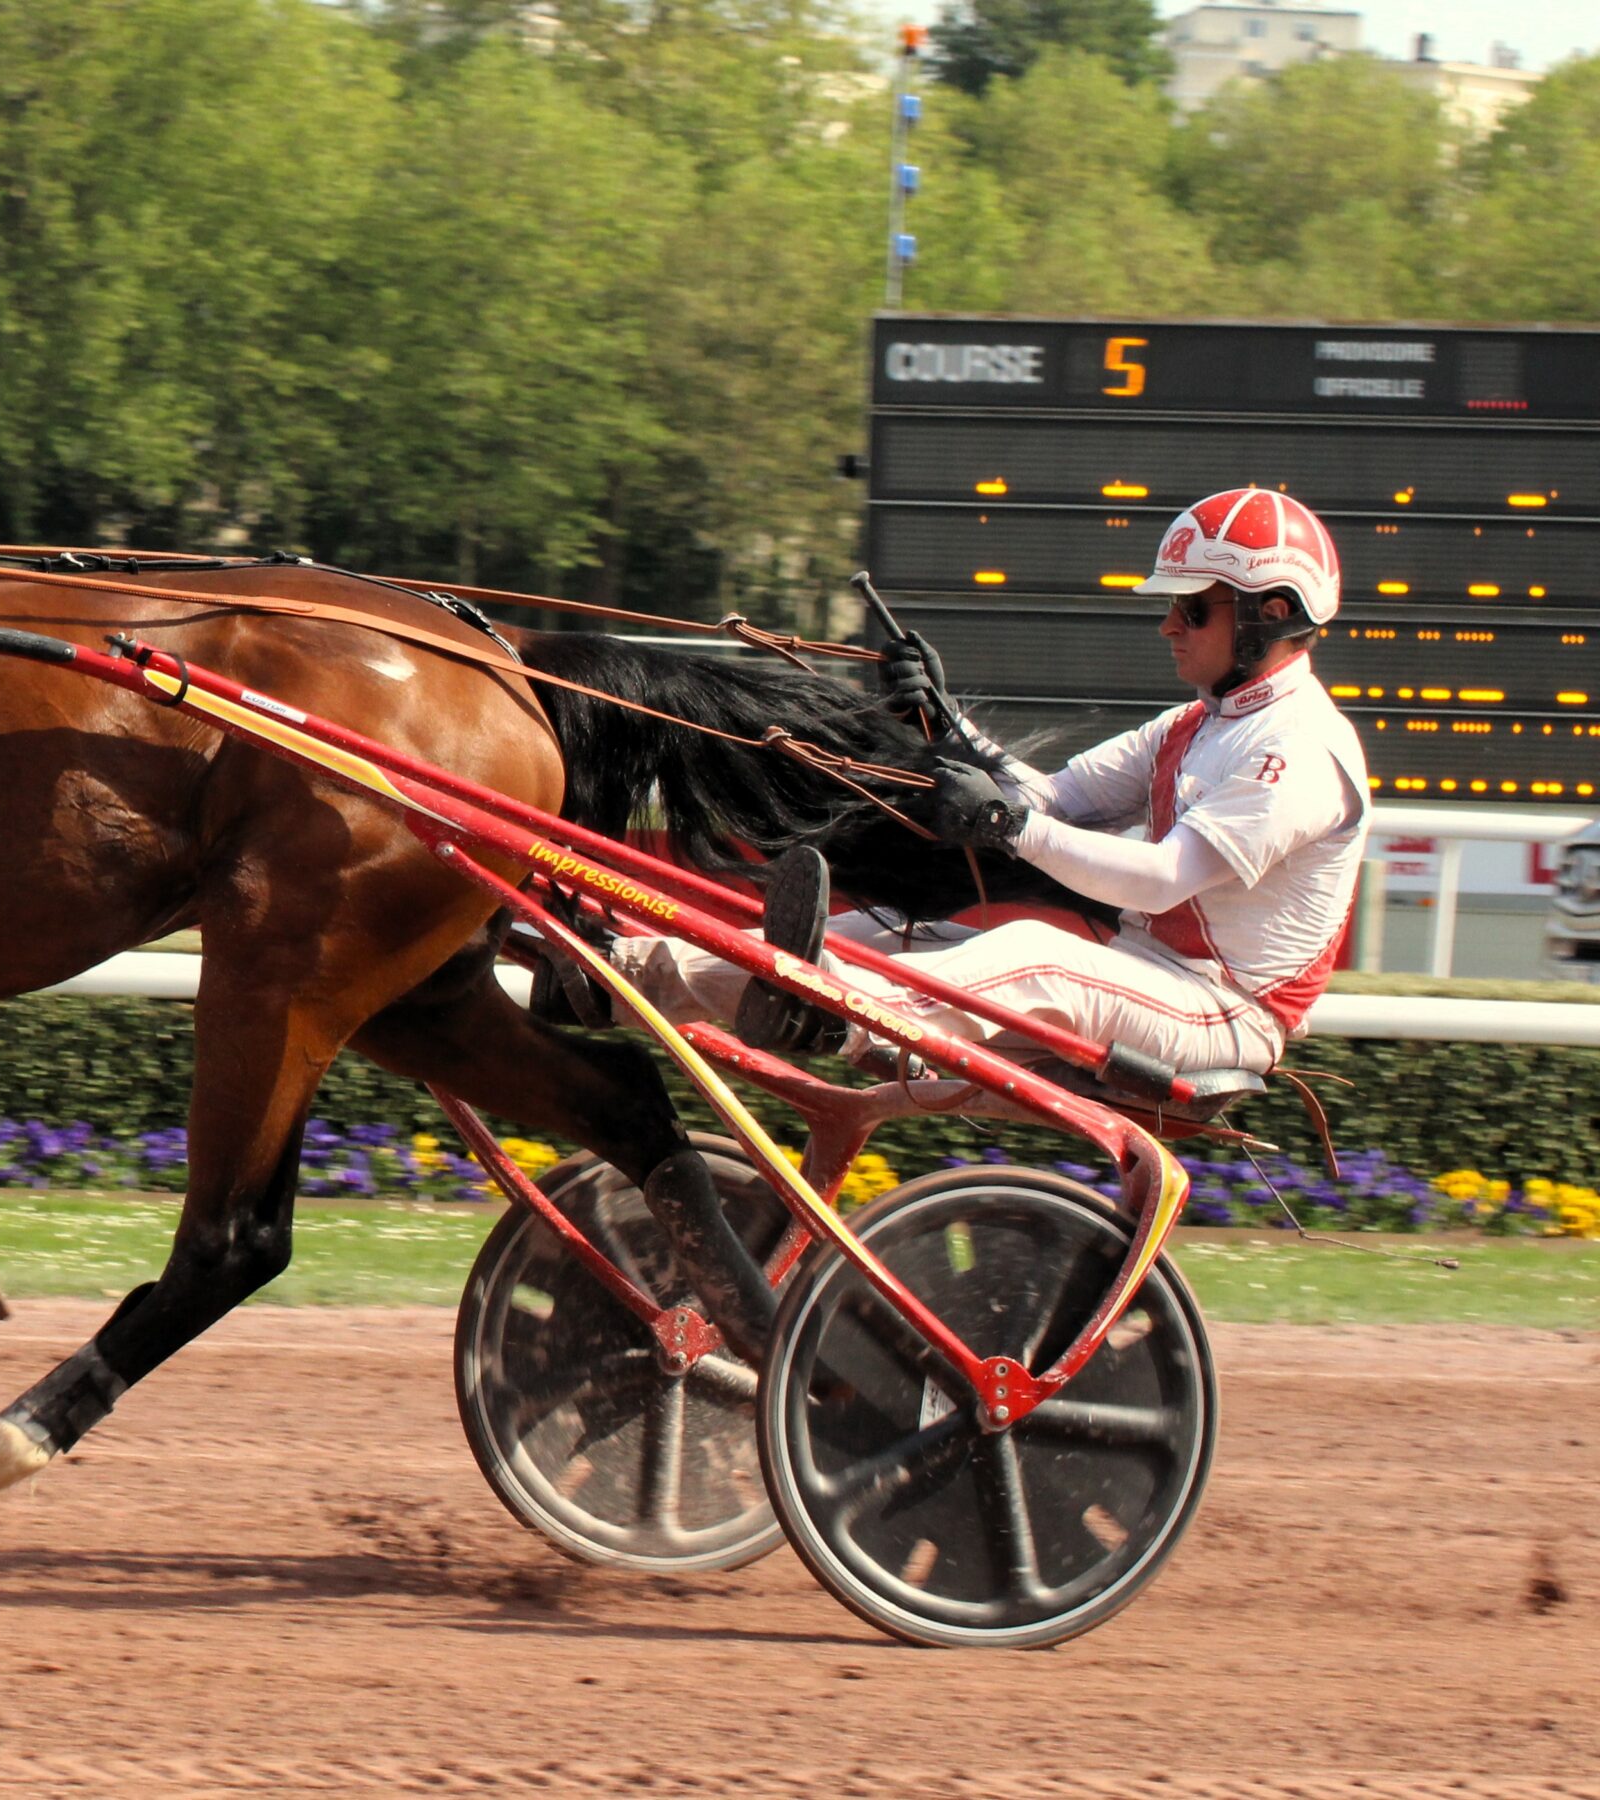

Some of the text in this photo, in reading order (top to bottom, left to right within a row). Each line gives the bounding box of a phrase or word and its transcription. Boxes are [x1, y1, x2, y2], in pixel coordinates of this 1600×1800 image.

[885, 336, 1149, 397] COURSE 5
[1246, 551, 1280, 571] Louis
[1255, 753, 1287, 785] B
[527, 840, 681, 921] Impressionist
[845, 991, 924, 1042] Chrono
